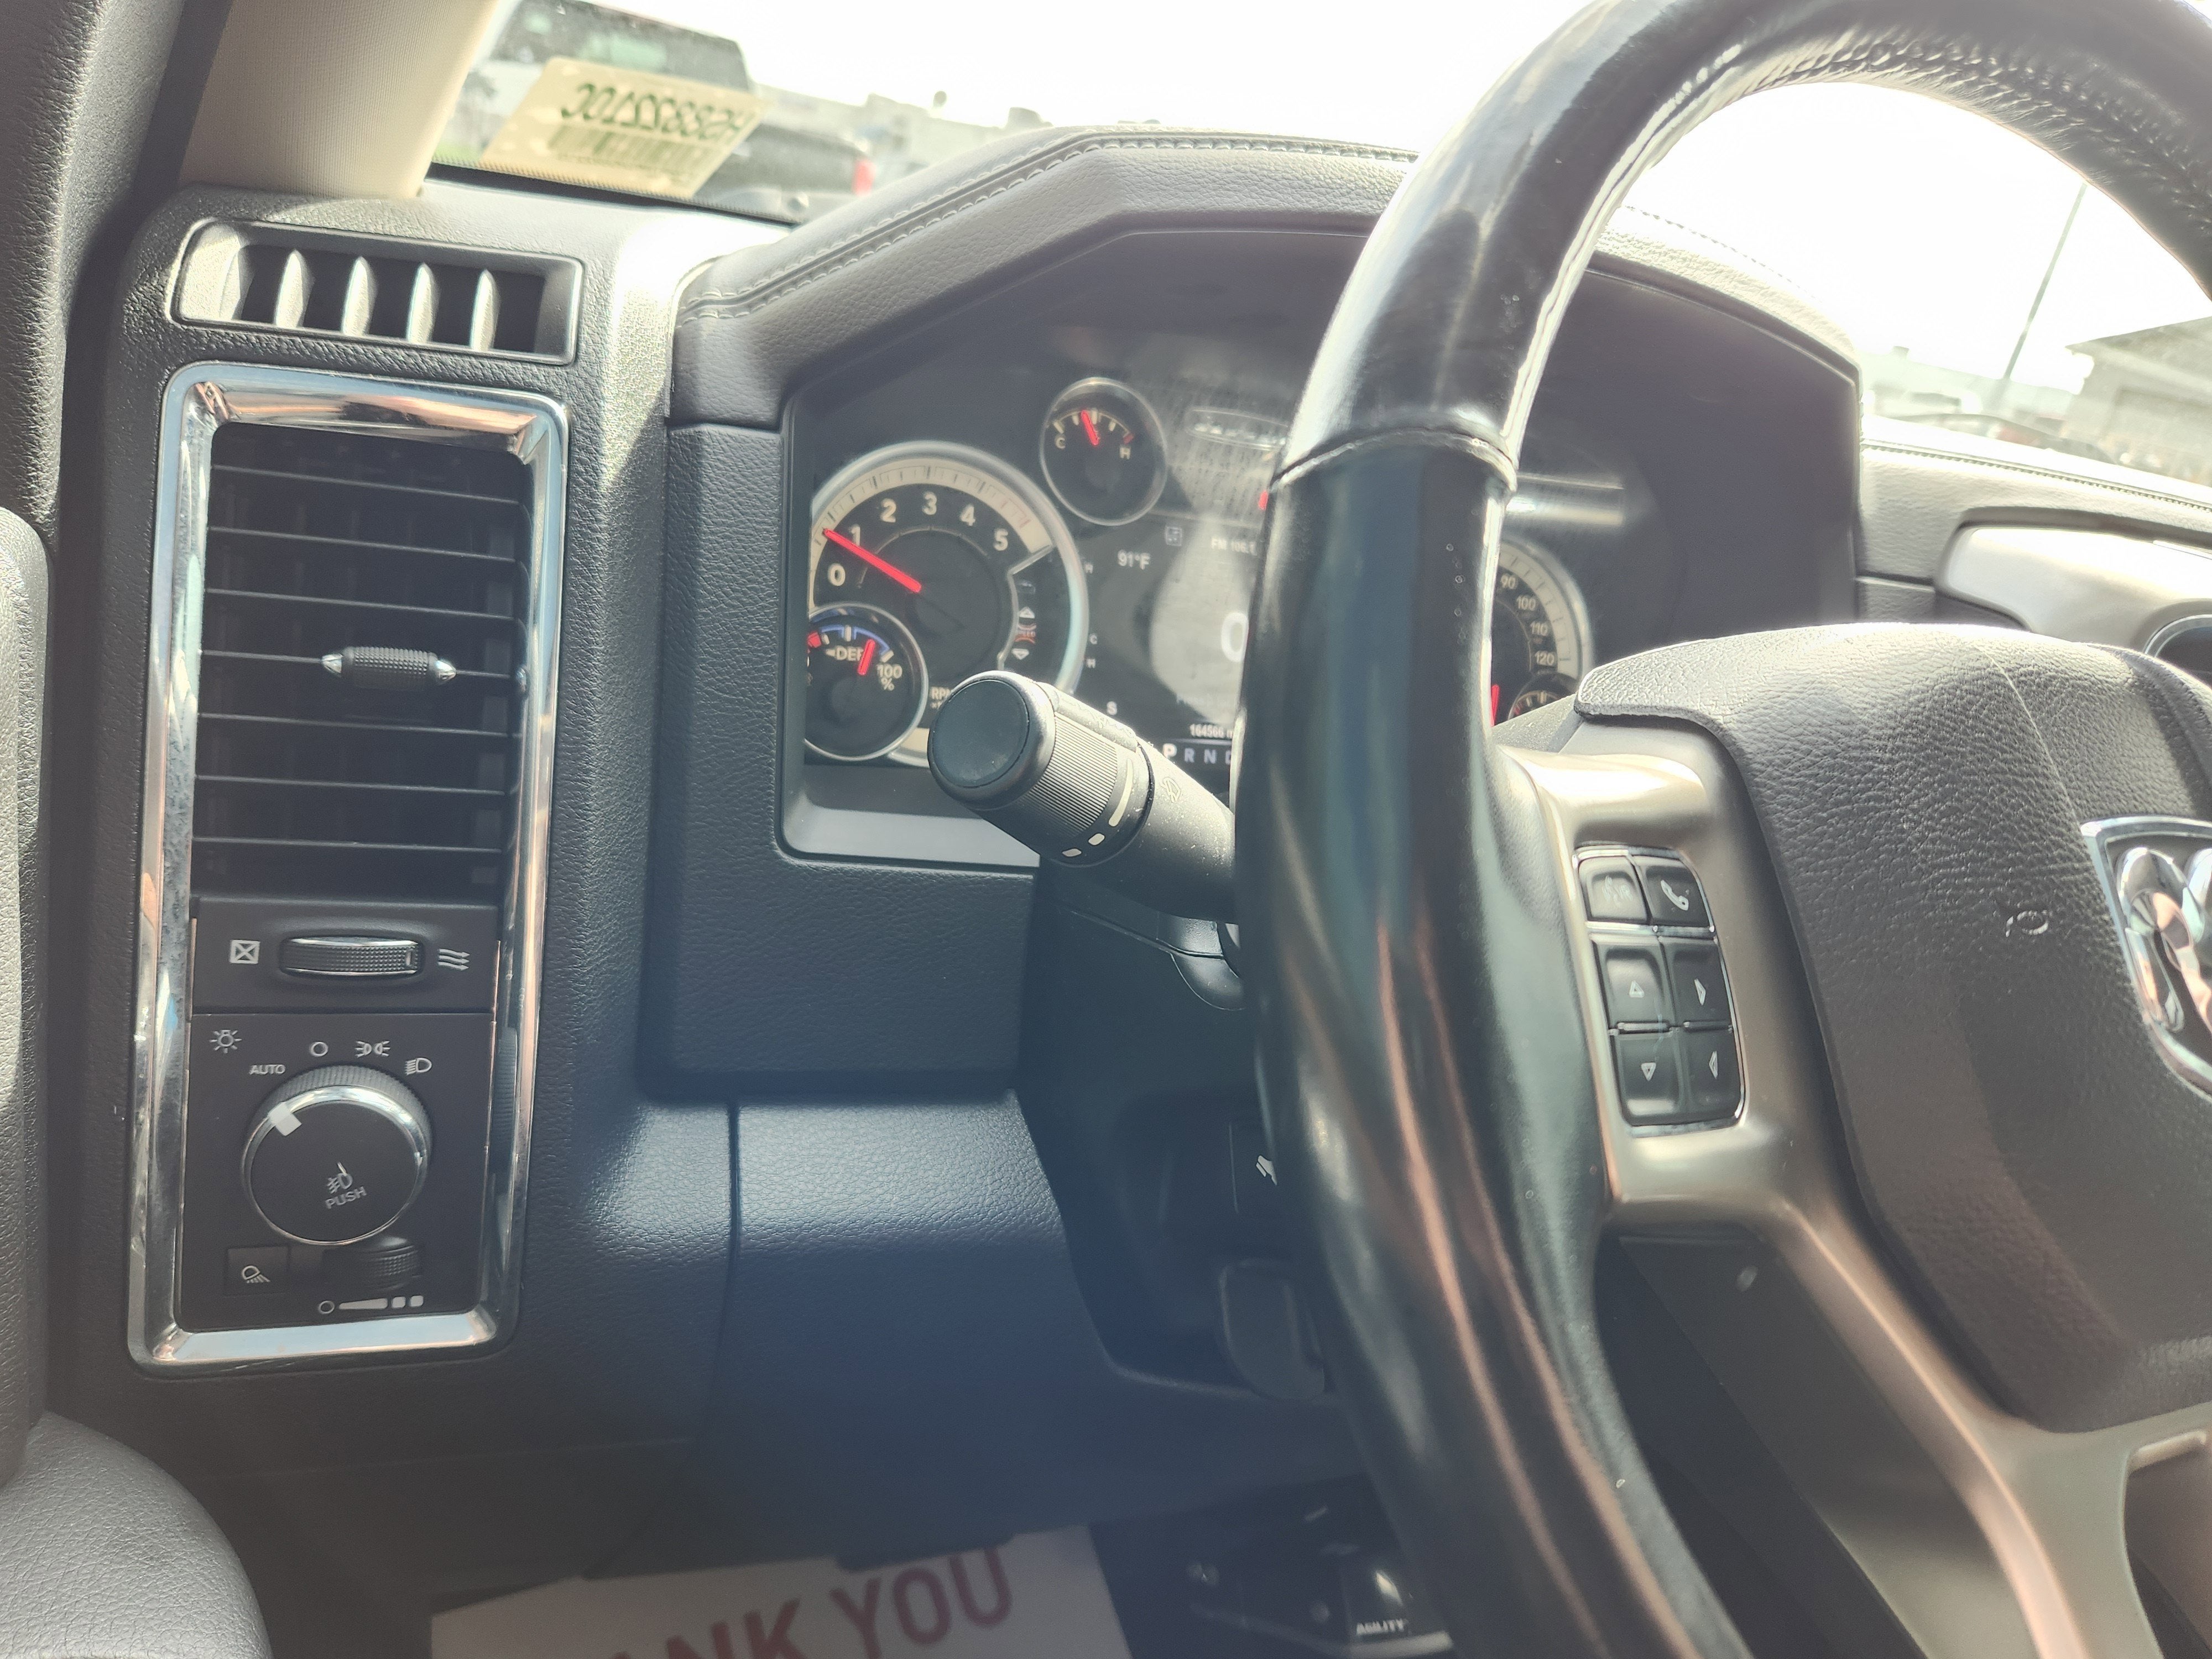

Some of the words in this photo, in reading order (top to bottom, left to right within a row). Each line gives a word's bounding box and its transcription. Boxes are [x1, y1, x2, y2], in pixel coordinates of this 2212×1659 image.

[1055, 436, 1066, 449] C
[1120, 446, 1131, 460] H
[880, 499, 896, 523] 2
[923, 491, 938, 515] 3
[959, 505, 976, 526] 4
[849, 525, 862, 545] 1
[995, 529, 1009, 551] 5
[828, 563, 846, 586] 0
[1500, 573, 1516, 590] 90
[1516, 594, 1536, 612] 100
[1530, 620, 1548, 637] 110
[1535, 650, 1555, 666] 120
[877, 664, 903, 679] 100
[880, 677, 895, 691] %
[1107, 701, 1118, 716] S
[1164, 743, 1177, 759] P
[1185, 748, 1195, 763] R
[1203, 748, 1217, 764] N
[249, 1064, 286, 1076] AUTO
[325, 1186, 367, 1209] PUSH
[830, 1548, 1012, 1659] YOU
